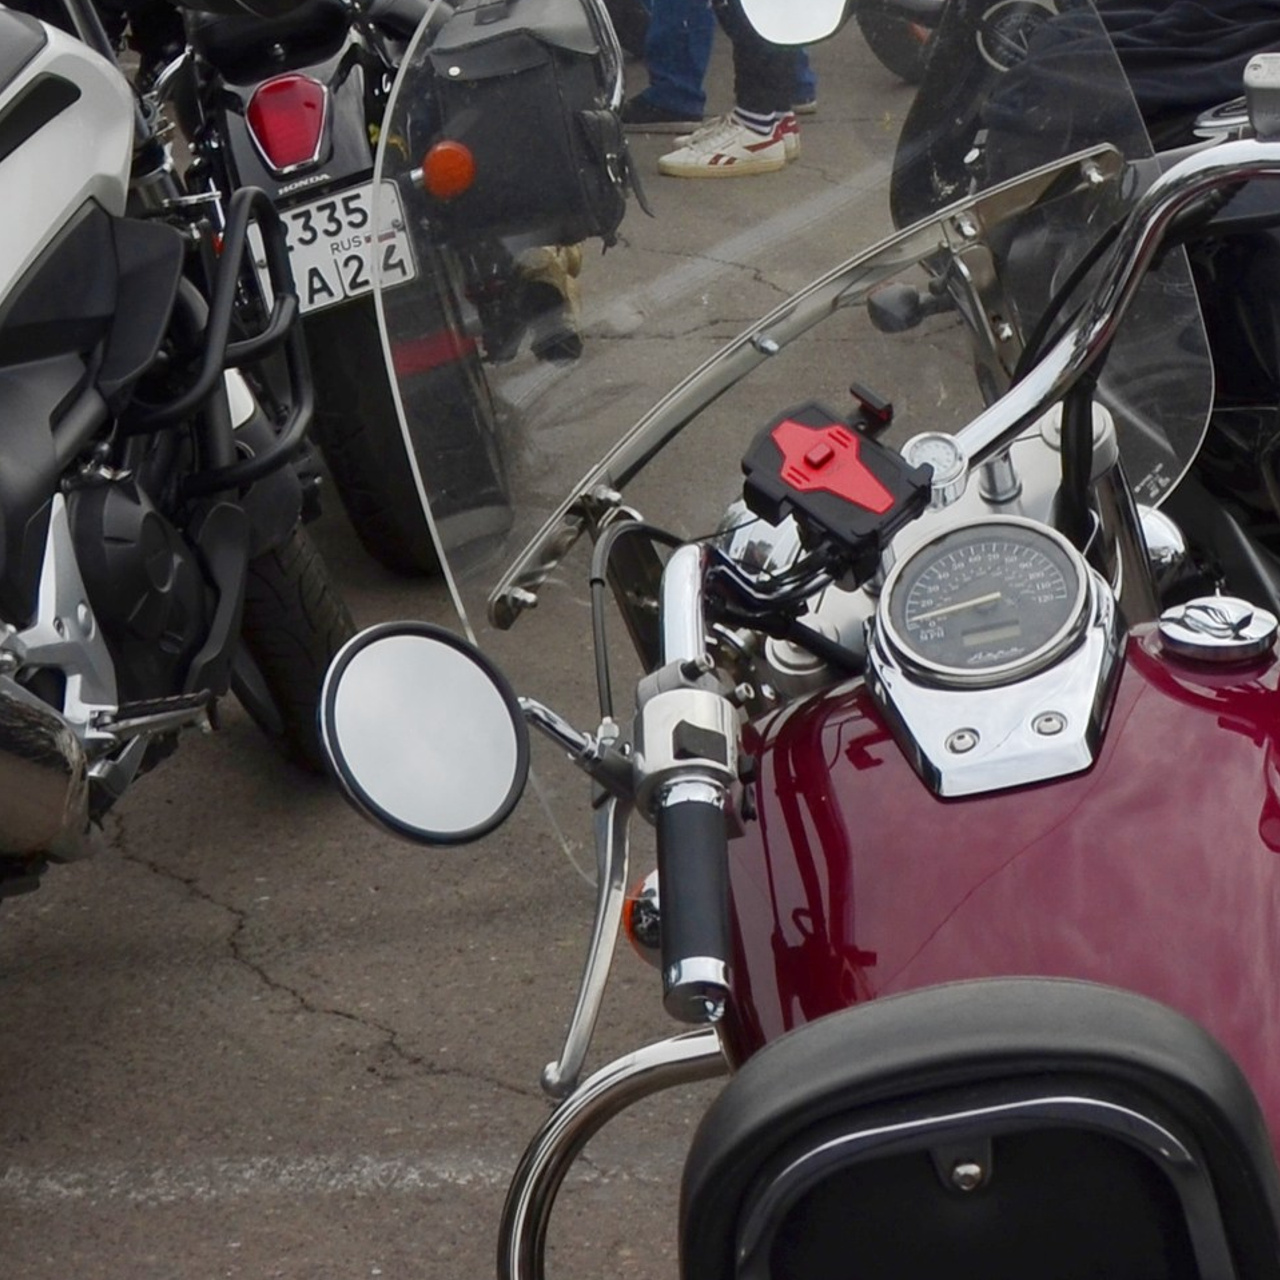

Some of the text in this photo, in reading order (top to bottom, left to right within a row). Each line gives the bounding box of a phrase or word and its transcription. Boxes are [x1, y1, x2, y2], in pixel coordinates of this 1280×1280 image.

[278, 173, 332, 195] HONDA
[288, 192, 369, 252] 335
[330, 235, 363, 255] RUS
[308, 244, 408, 305] A 24
